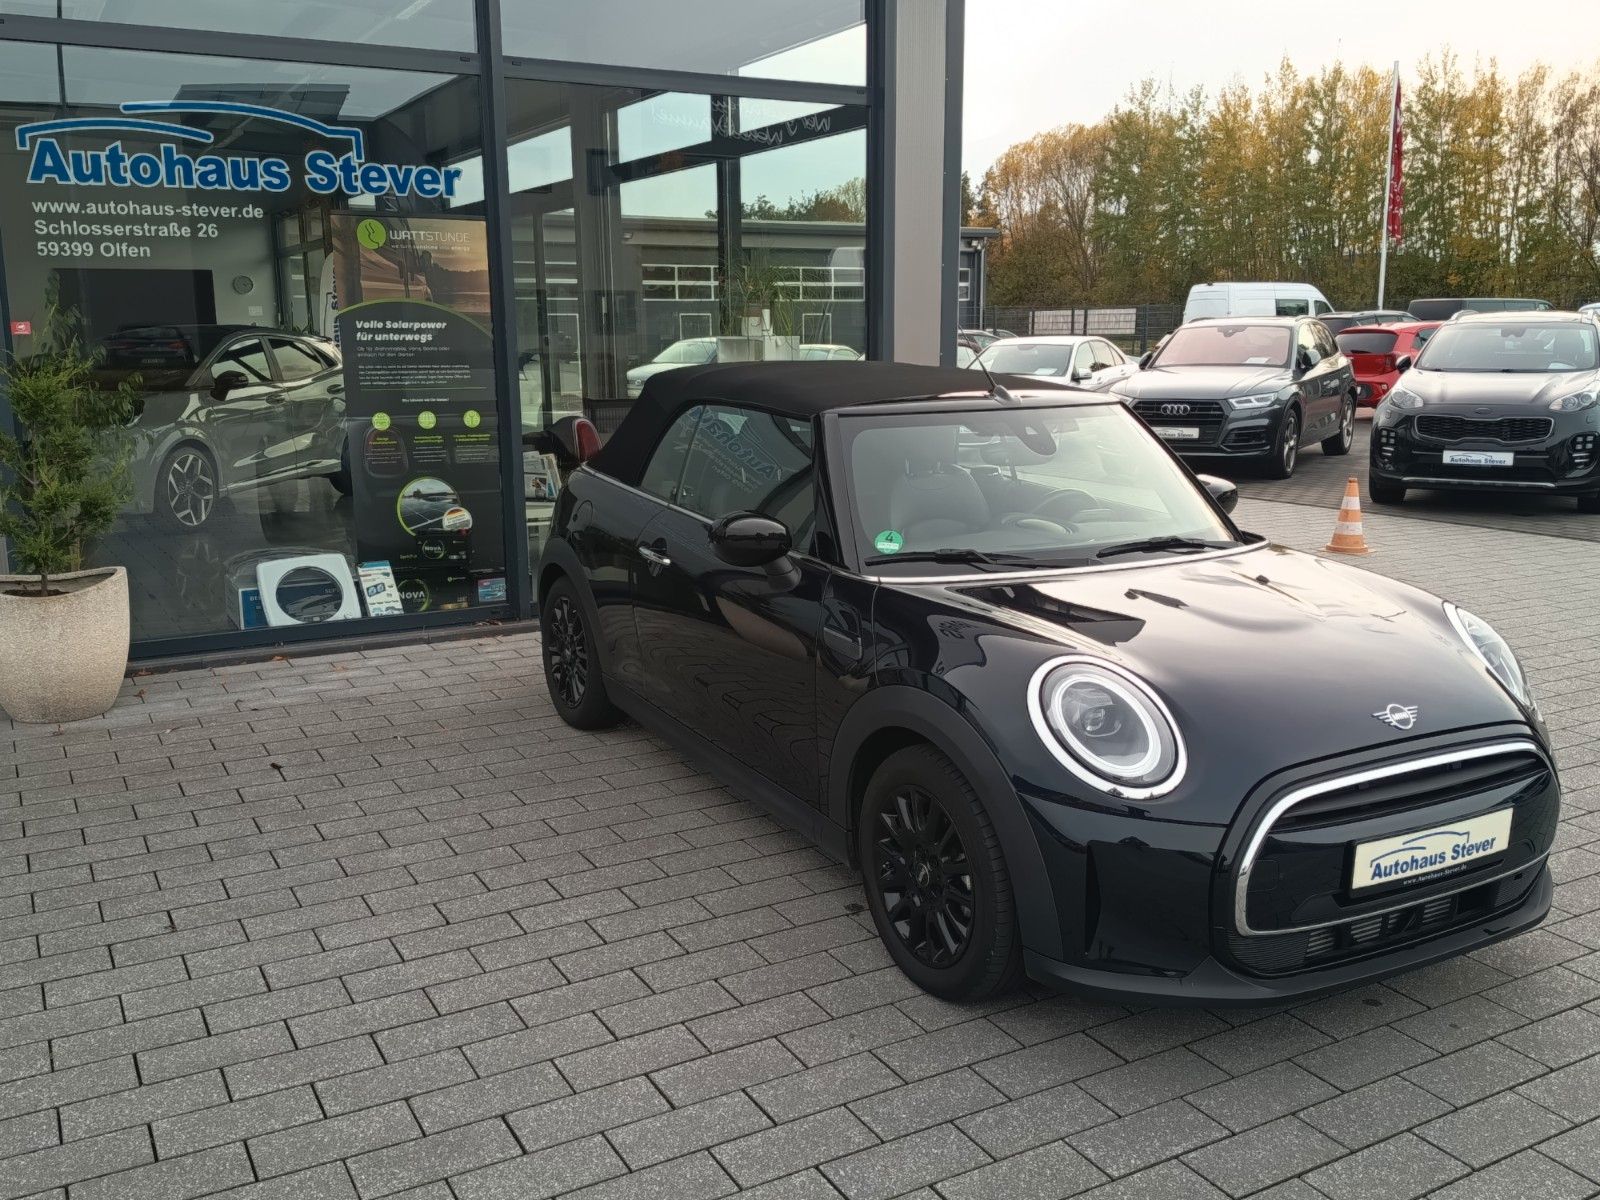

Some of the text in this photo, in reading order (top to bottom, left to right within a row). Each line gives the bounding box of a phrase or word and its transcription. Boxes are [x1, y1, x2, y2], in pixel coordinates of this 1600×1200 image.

[27, 138, 463, 198] Autohaus Stever
[32, 201, 264, 219] www.autohaus-stever.de
[34, 220, 219, 238] Schlosserstraße 26
[389, 230, 471, 243] WATTSTUNDE
[37, 242, 151, 258] 59399 Olfen
[355, 320, 447, 331] Volle Solarpower
[356, 332, 433, 343] für unterwegs
[885, 531, 893, 542] 4
[1370, 837, 1496, 881] Autohaus Stever
